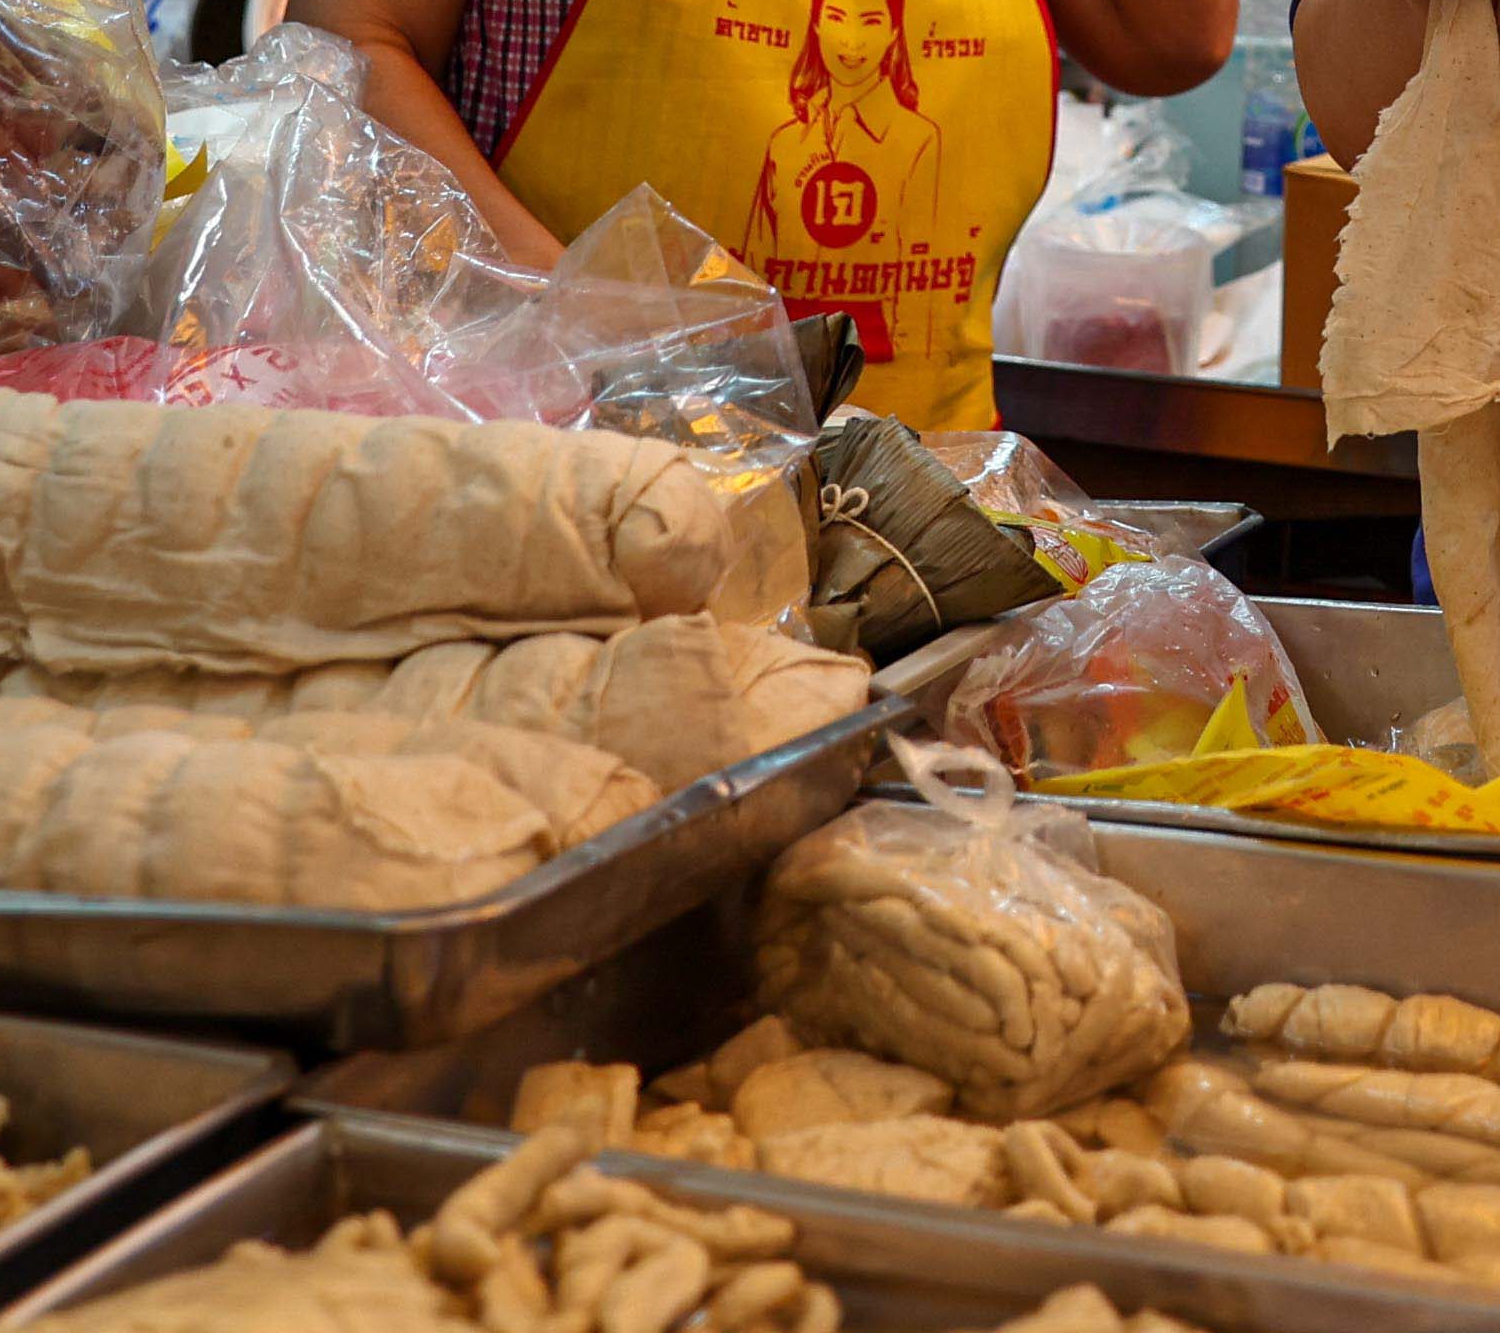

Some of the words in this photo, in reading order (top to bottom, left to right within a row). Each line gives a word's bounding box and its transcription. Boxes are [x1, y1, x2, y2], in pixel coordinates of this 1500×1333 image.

[714, 0, 791, 49] ค้าขาย
[815, 179, 865, 226] เจ
